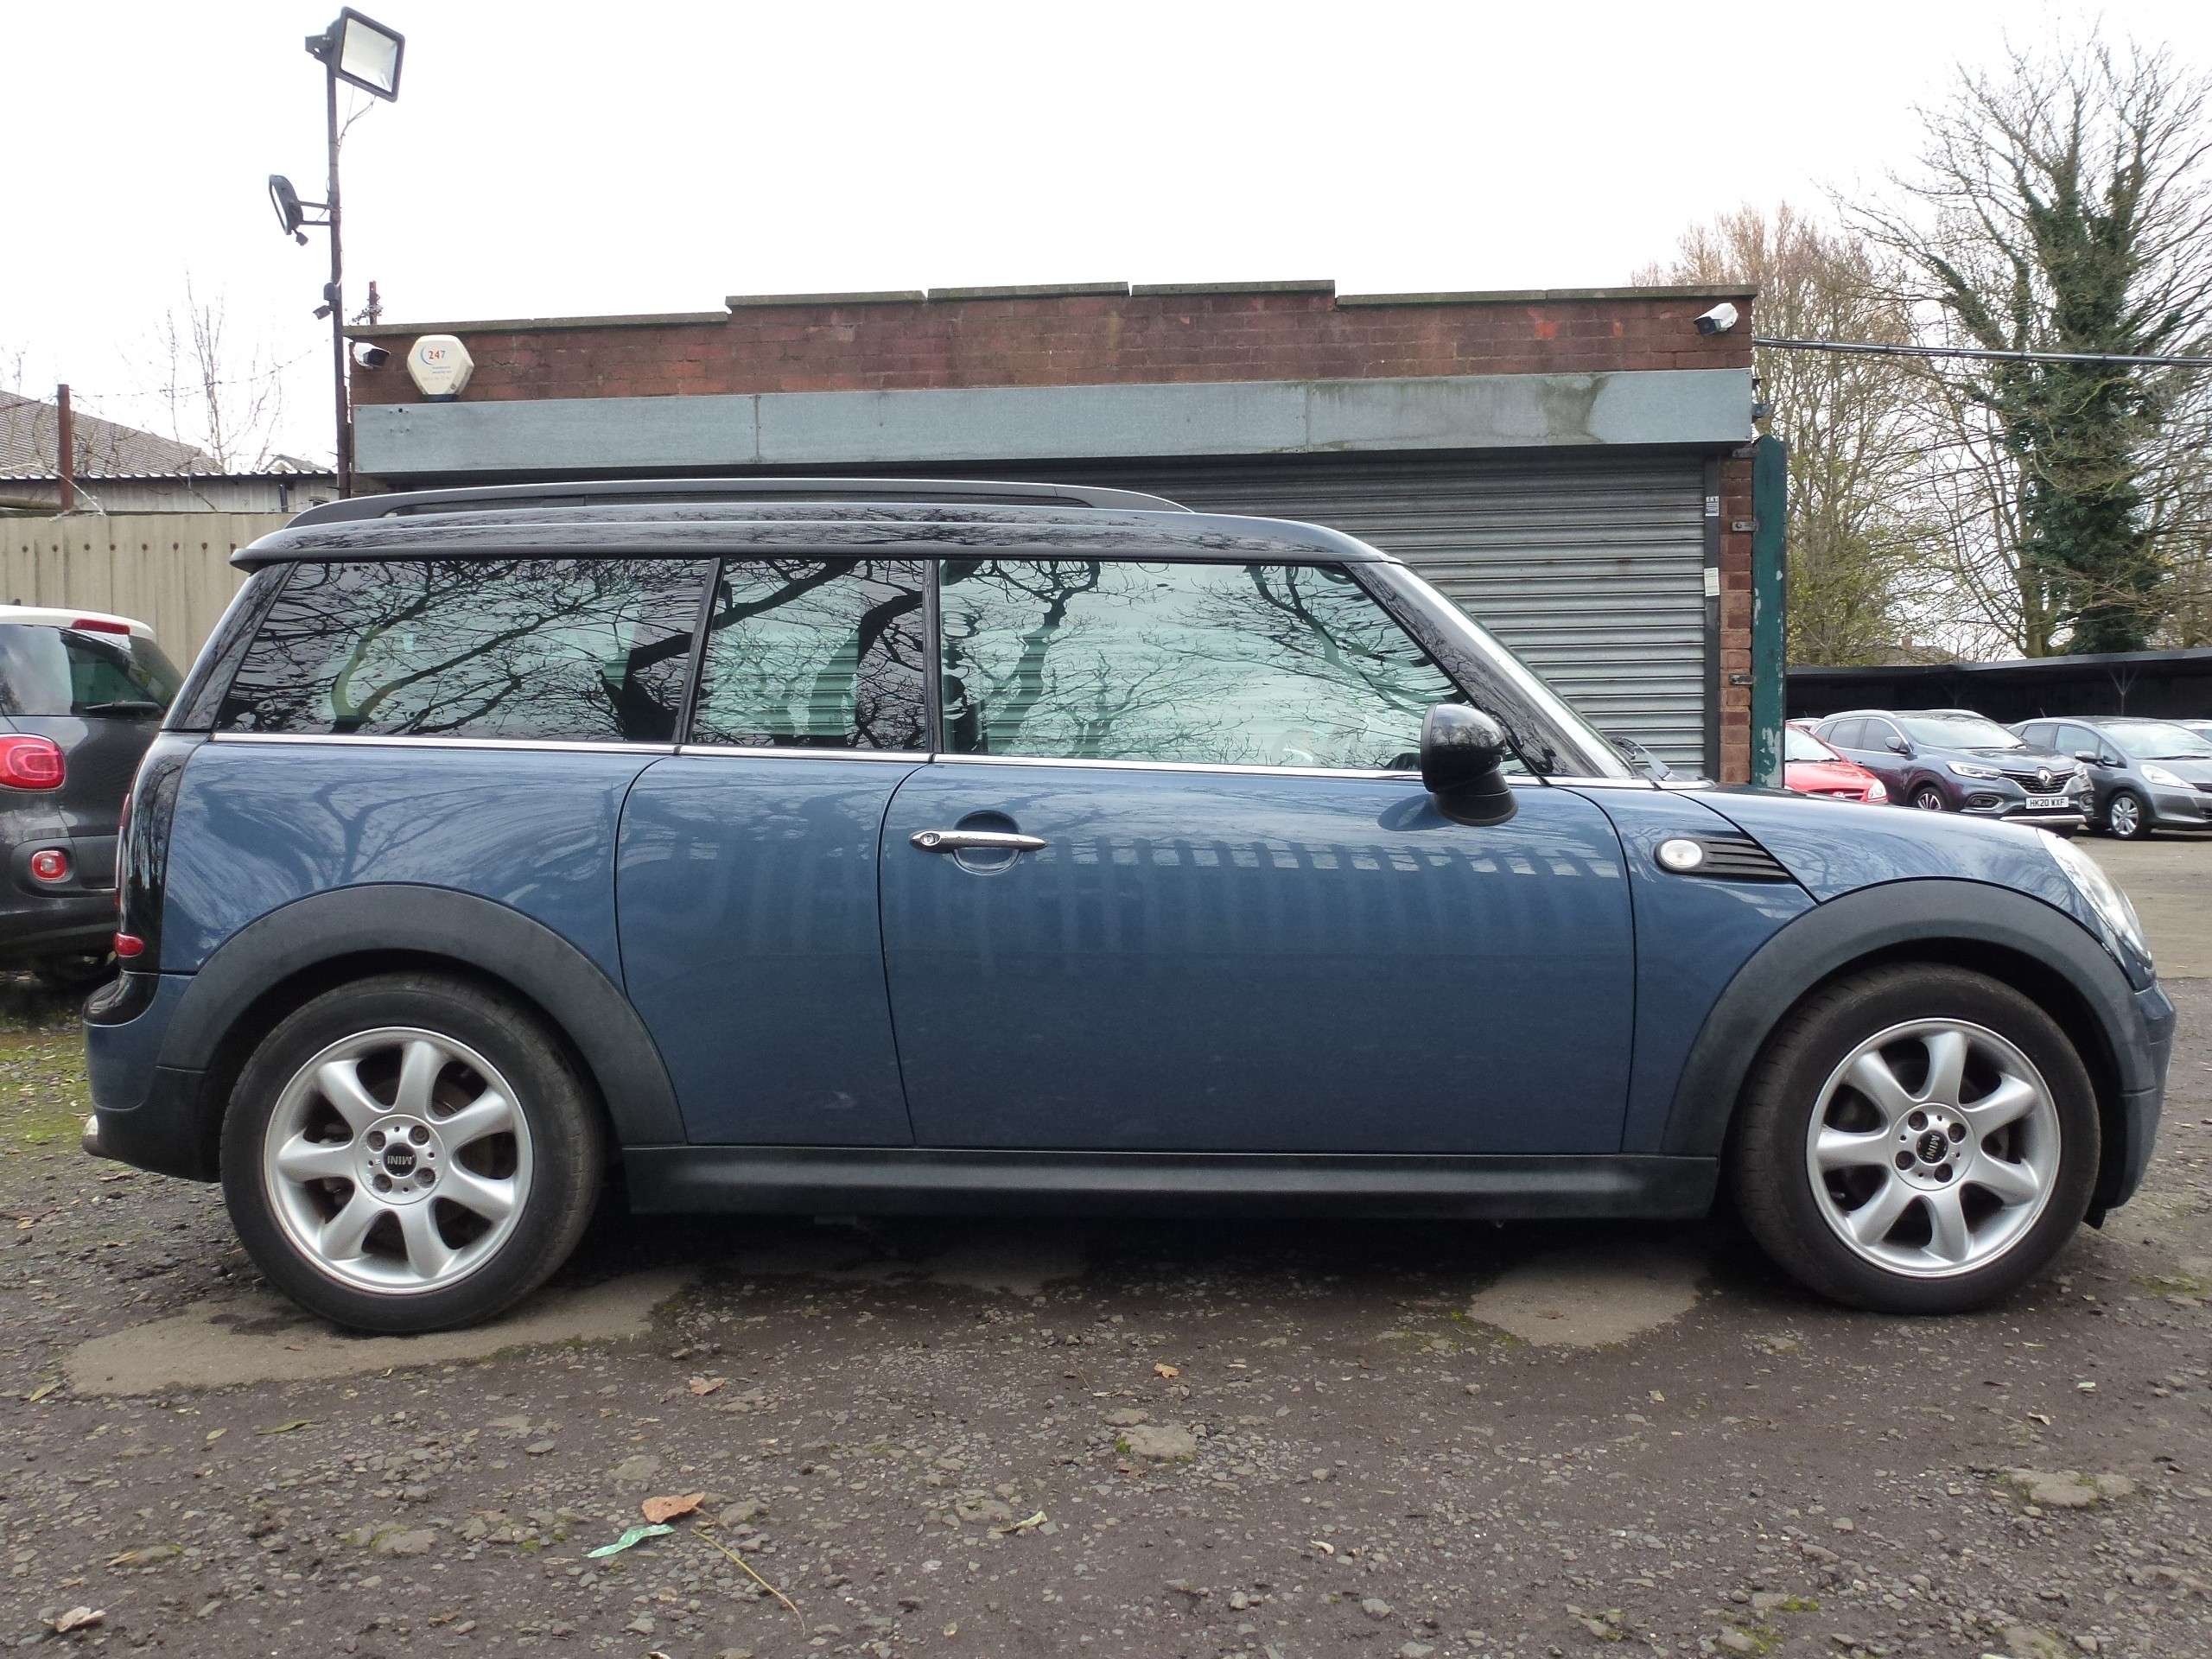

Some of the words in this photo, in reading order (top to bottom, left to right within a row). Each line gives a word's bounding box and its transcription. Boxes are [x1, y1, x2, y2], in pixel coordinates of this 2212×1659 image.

[429, 350, 446, 359] 247
[2030, 798, 2049, 807] HK20
[1925, 1135, 1940, 1160] MINI
[387, 1155, 413, 1166] MINI
